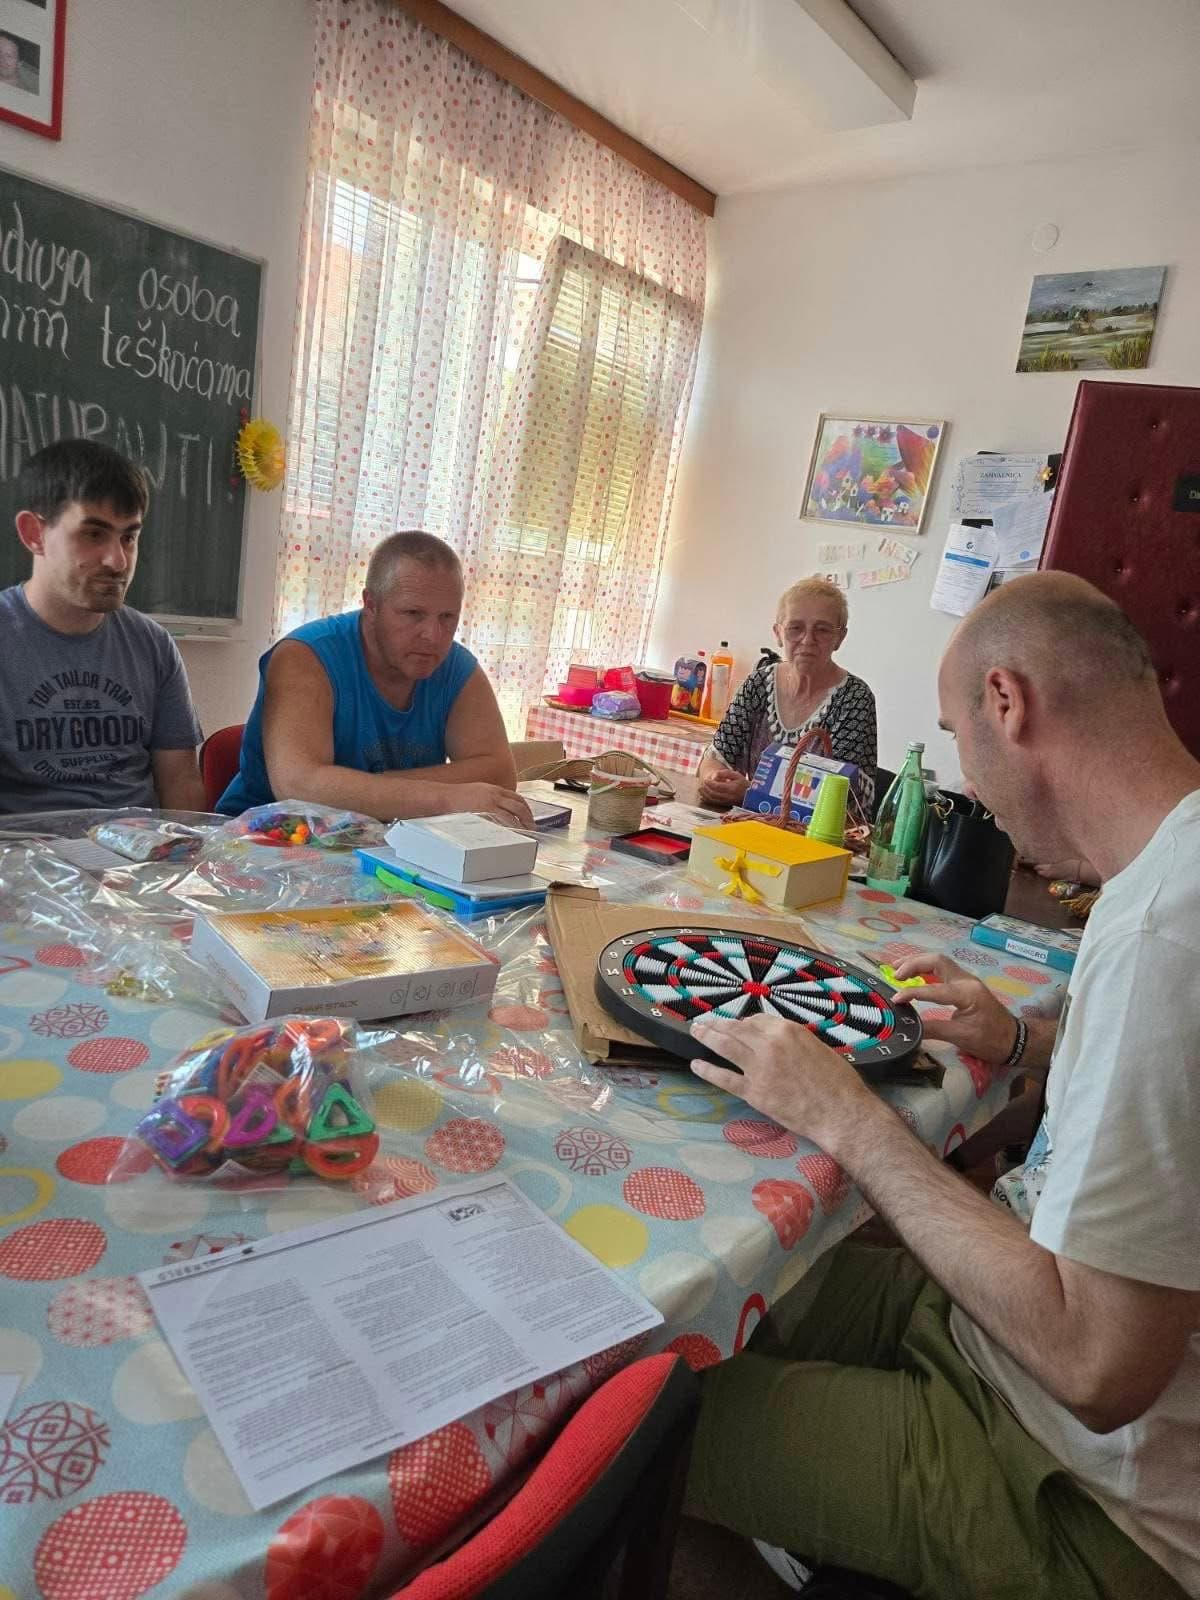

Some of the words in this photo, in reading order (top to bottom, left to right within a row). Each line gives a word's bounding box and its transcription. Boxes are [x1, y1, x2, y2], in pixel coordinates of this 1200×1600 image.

[0, 201, 93, 306] druga
[101, 304, 252, 406] teškoćama
[28, 681, 57, 708] TOM
[53, 669, 99, 689] TAILOR
[608, 951, 619, 959] 9
[606, 968, 620, 976] 14
[621, 987, 635, 996] 11
[650, 1007, 663, 1018] 8
